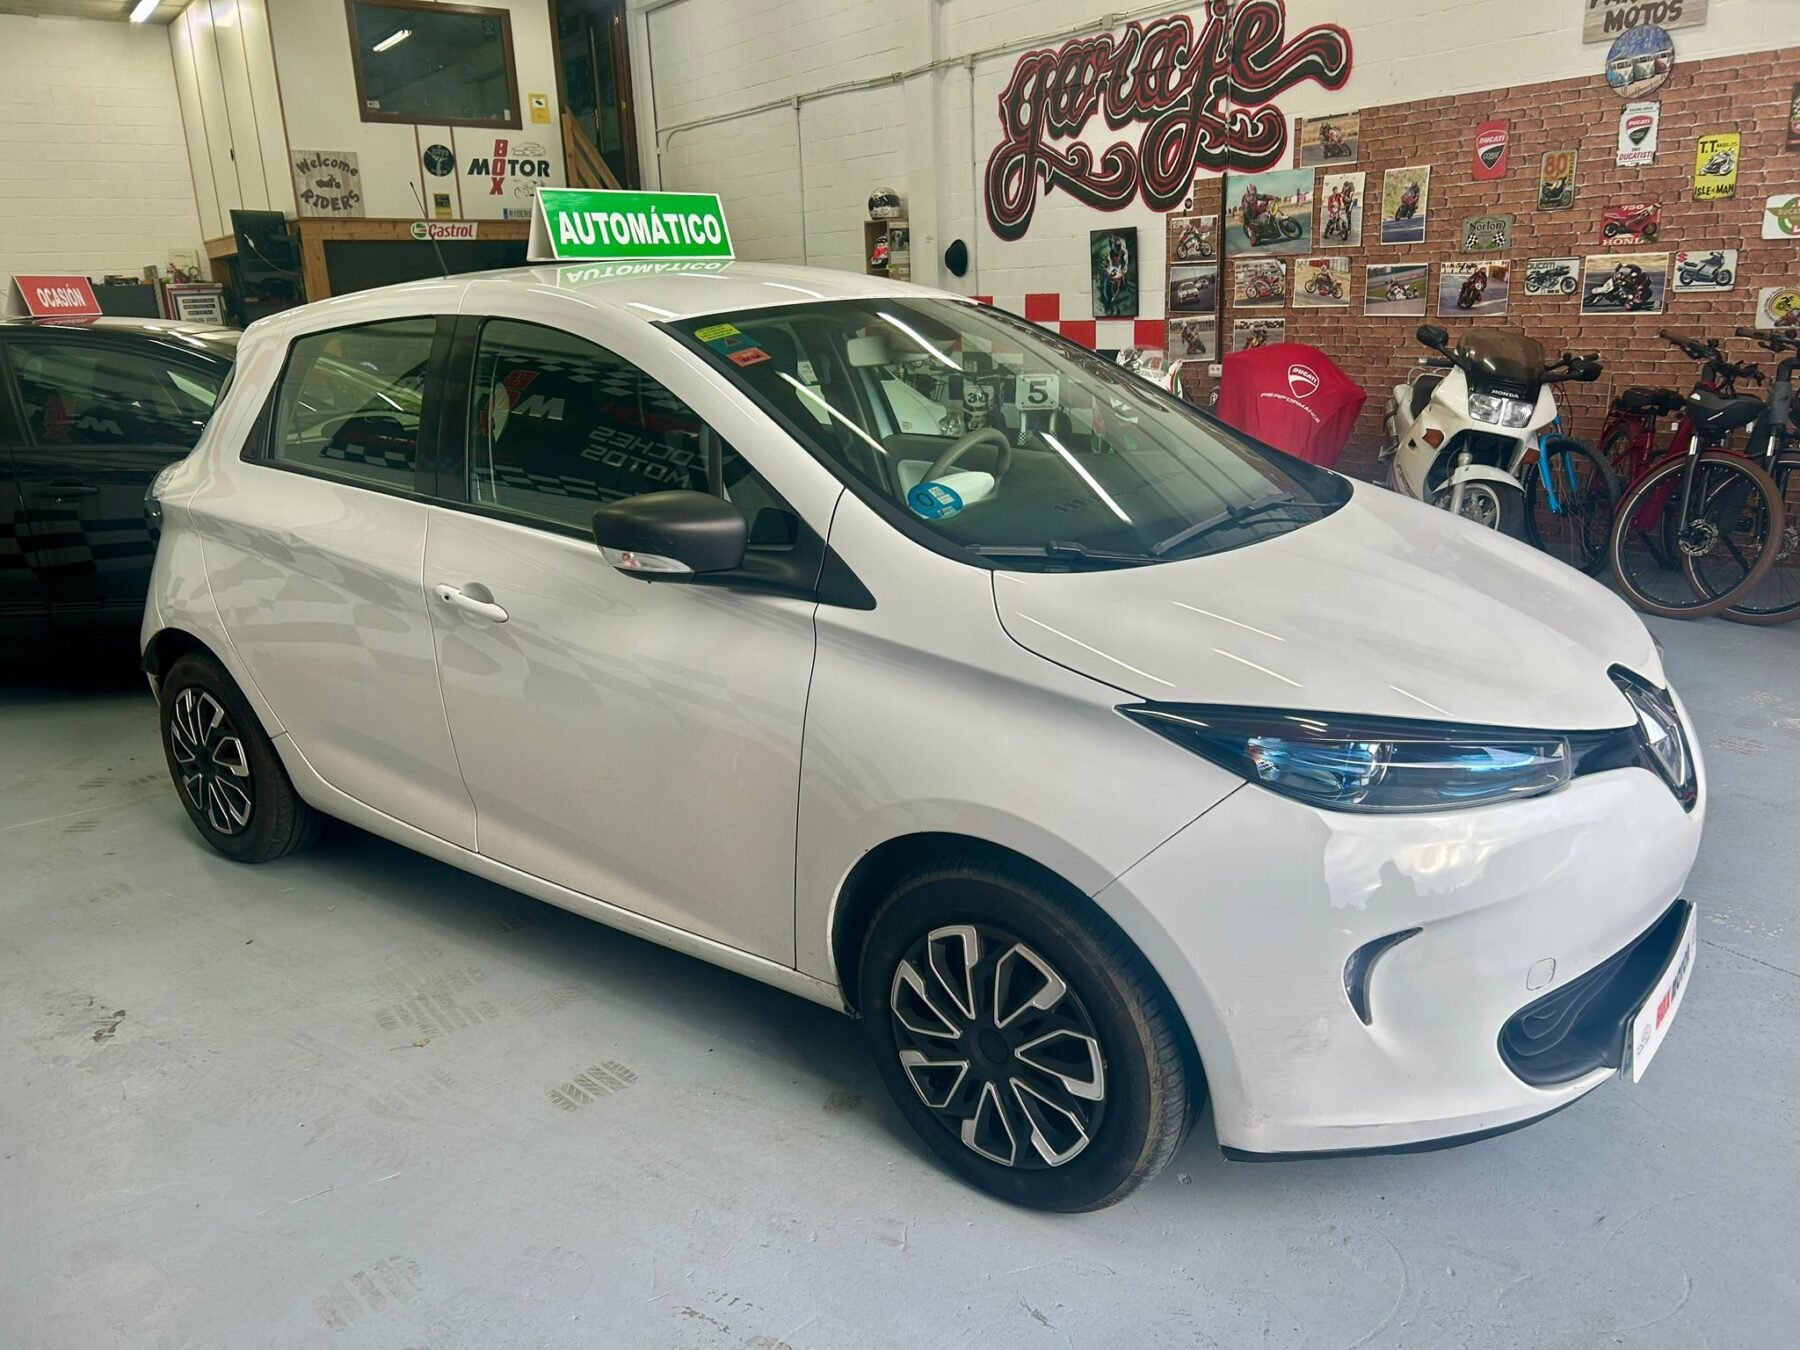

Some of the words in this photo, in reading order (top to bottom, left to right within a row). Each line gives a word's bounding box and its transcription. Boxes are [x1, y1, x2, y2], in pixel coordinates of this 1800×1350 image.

[1603, 0, 1683, 33] MOTOS
[984, 0, 1353, 242] garaje
[1478, 135, 1506, 144] DUCATI
[296, 152, 359, 177] Welcome
[467, 158, 550, 177] MOTOR
[300, 188, 361, 212] RIDERS
[1695, 186, 1712, 196] ISLE
[1715, 183, 1734, 194] MAN
[428, 224, 473, 238] Castrol
[558, 206, 721, 245] AUTOMÁTICO
[1468, 221, 1506, 234] Norton
[36, 284, 86, 308] OCASIÓN
[1292, 367, 1318, 384] DUCATI
[1027, 381, 1049, 404] 5
[1491, 389, 1519, 399] HONDA
[1260, 392, 1321, 424] PERFORMANCE
